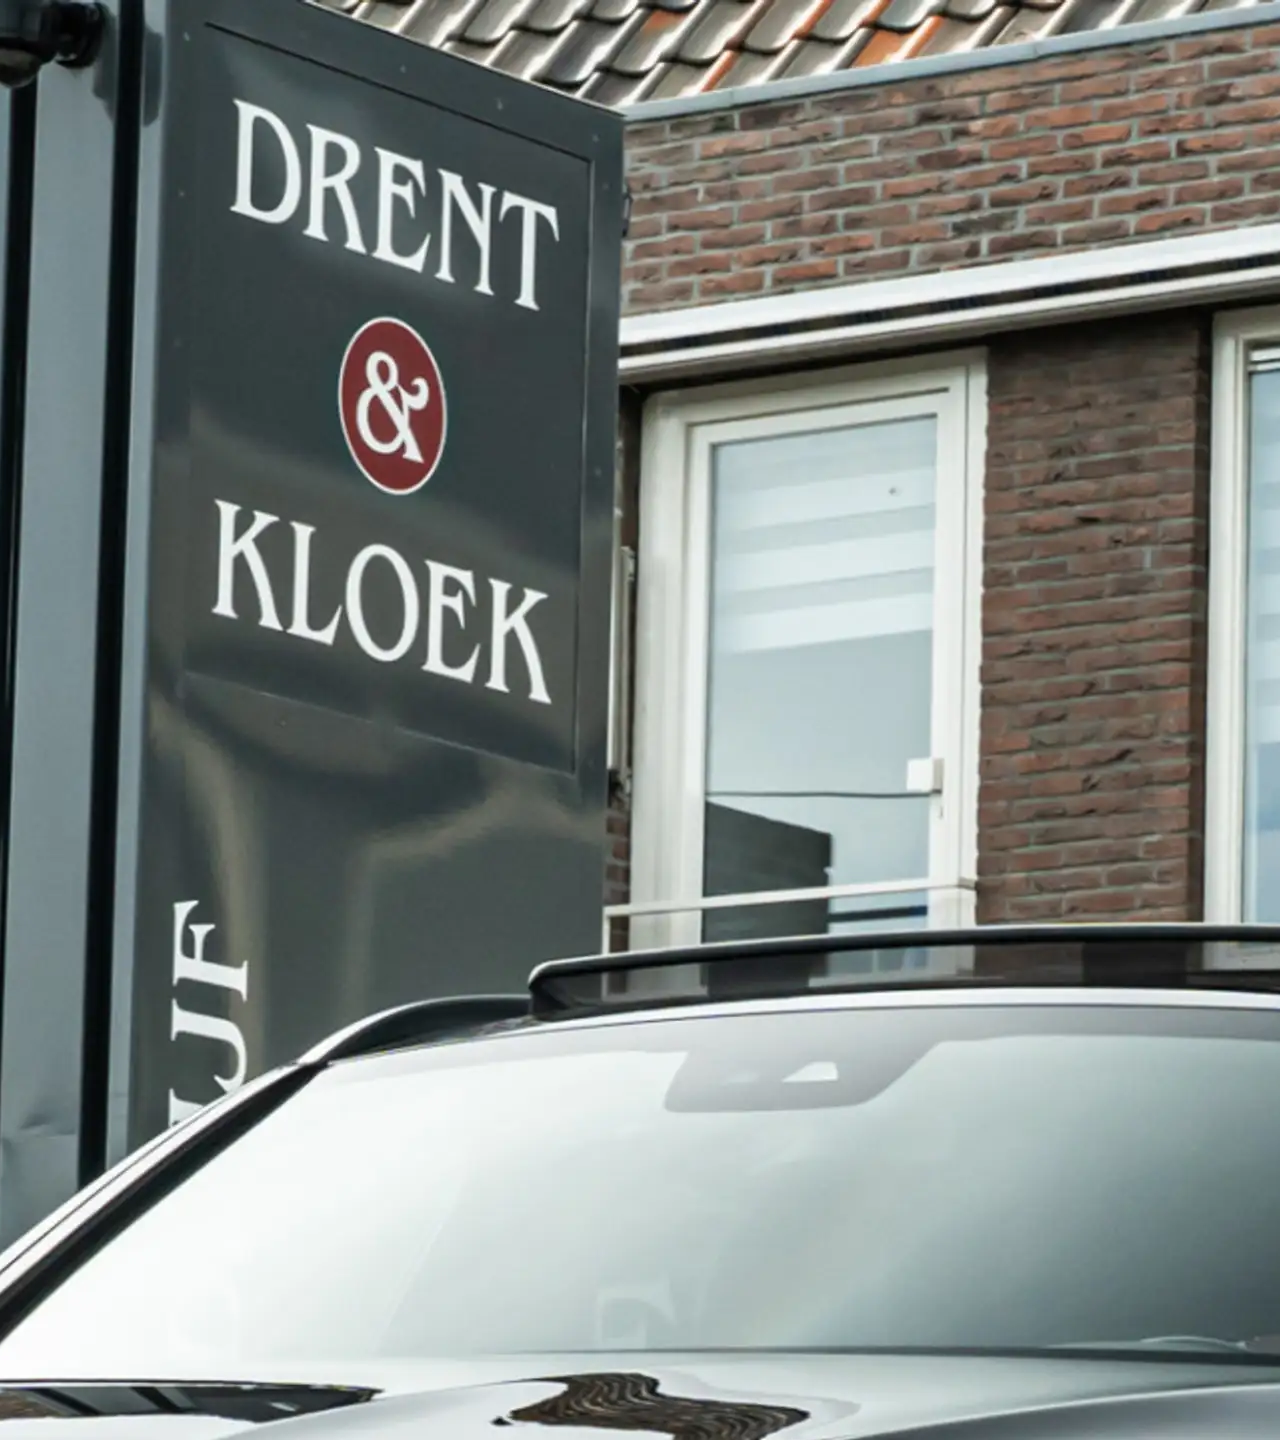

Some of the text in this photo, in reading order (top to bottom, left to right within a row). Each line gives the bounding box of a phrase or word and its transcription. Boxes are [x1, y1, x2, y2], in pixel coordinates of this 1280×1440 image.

[230, 99, 559, 310] DRENT
[356, 351, 429, 463] &
[211, 499, 552, 704] KLOEK
[168, 900, 248, 1127] JF
